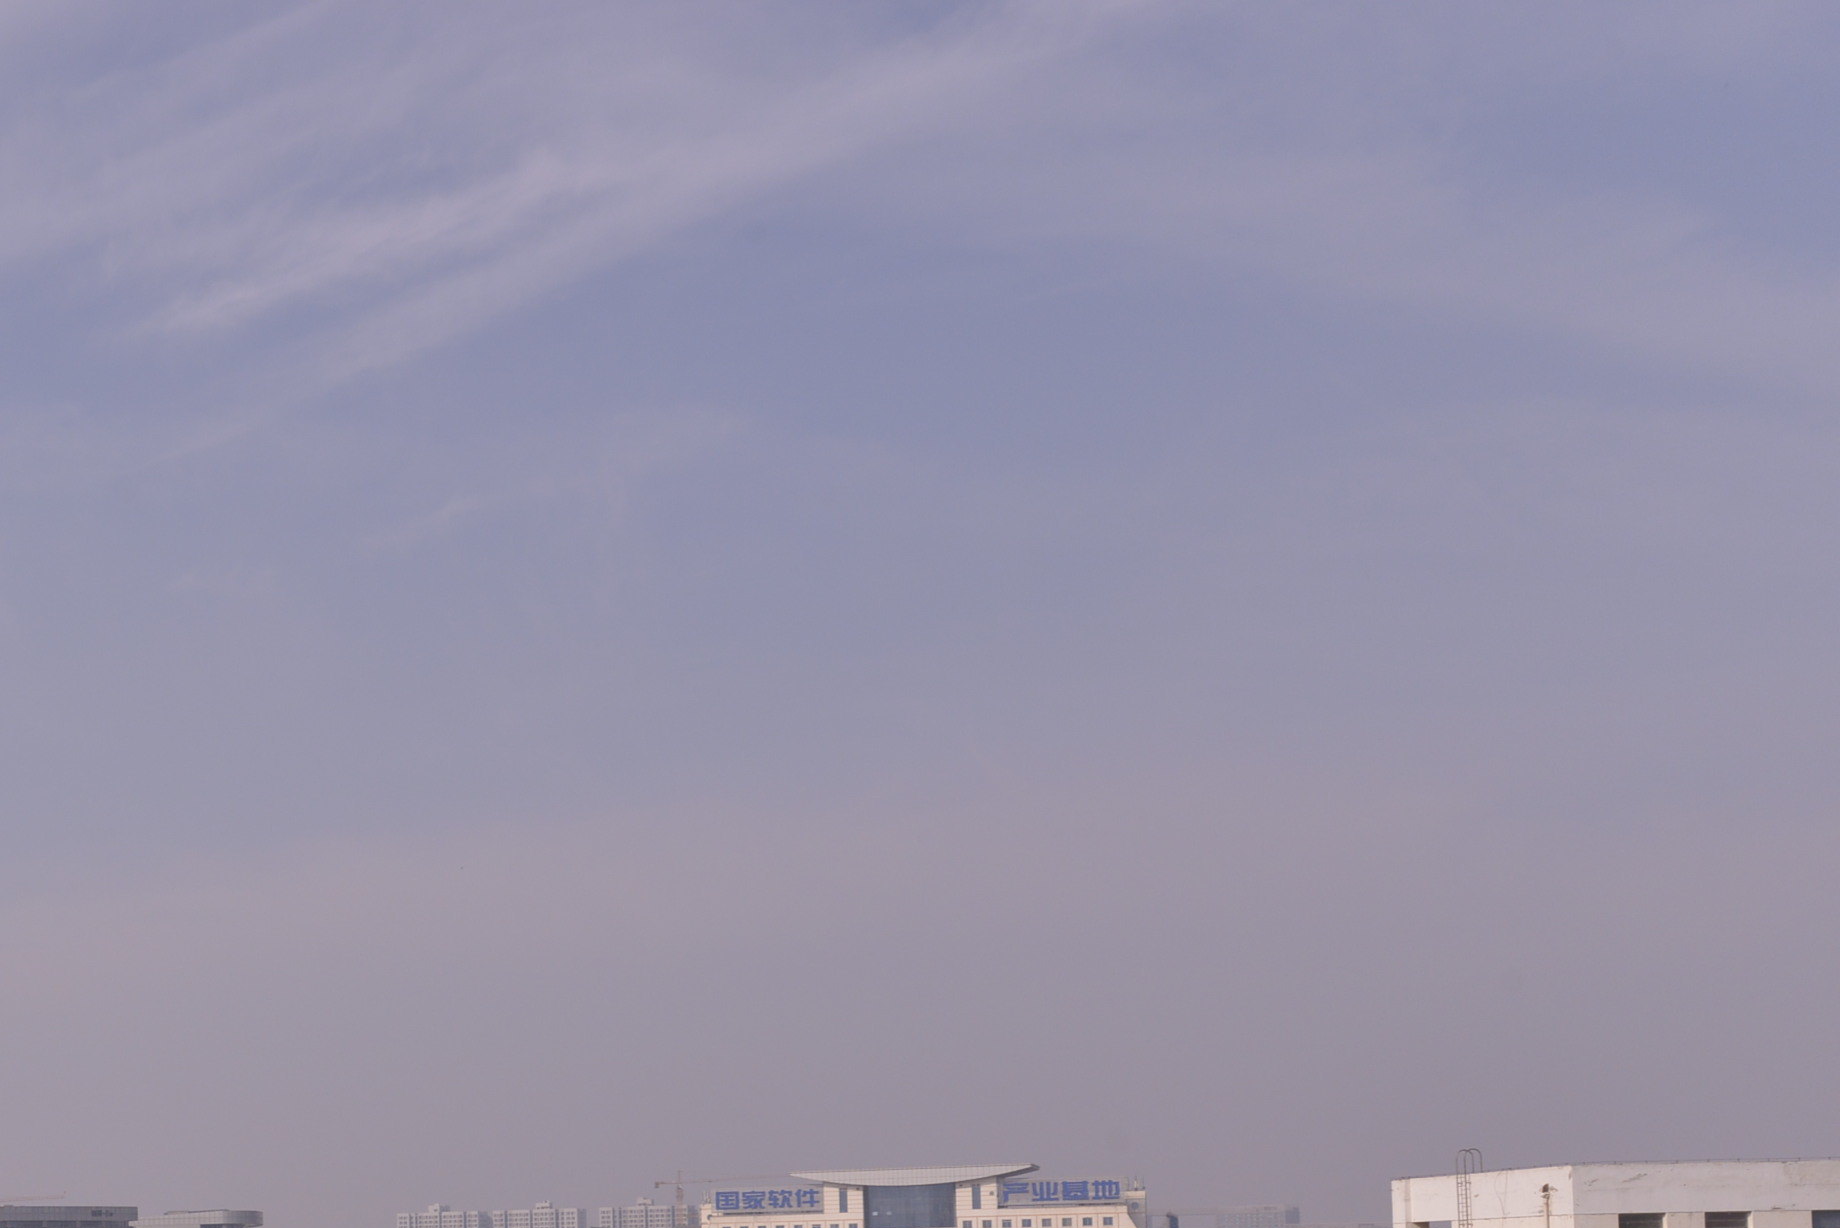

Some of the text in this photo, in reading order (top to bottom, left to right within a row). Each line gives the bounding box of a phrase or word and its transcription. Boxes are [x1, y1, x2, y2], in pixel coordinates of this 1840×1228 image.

[716, 1180, 1120, 1210] 国家软件 产业基地
